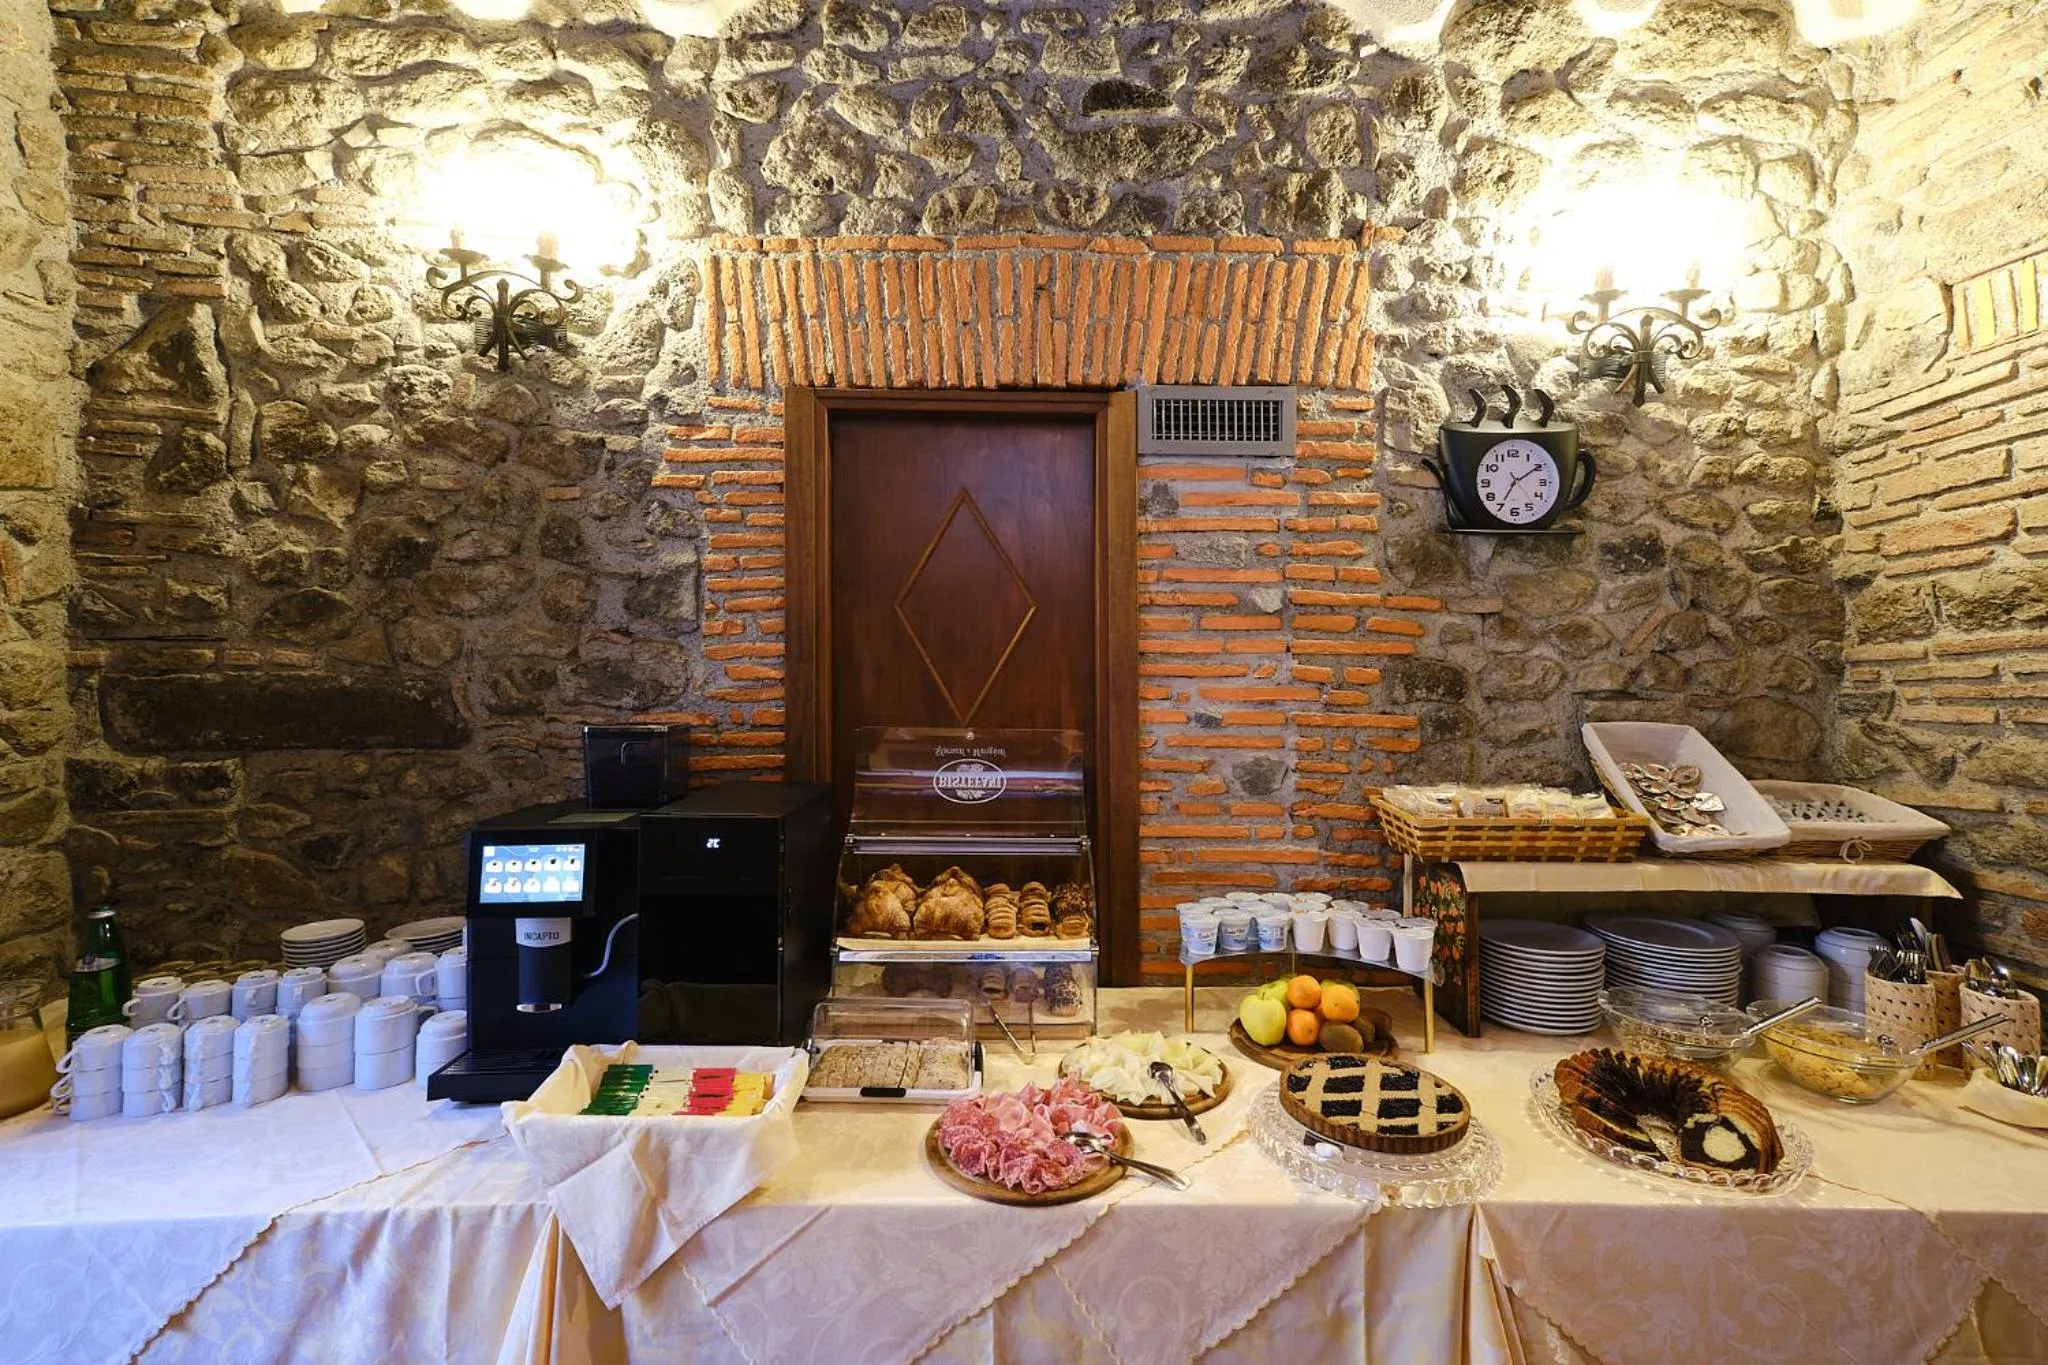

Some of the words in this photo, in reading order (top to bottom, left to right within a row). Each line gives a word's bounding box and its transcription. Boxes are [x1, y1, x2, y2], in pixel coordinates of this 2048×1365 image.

[1495, 453, 1504, 462] 11
[1507, 449, 1520, 458] 12
[1526, 453, 1530, 462] 1
[1486, 464, 1499, 473] 10
[1533, 463, 1543, 472] 2
[1480, 478, 1491, 488] 9
[1539, 478, 1547, 487] 3
[1486, 492, 1496, 502] 8
[1534, 491, 1543, 500] 4
[1496, 503, 1505, 512] 7
[1524, 502, 1534, 511] 5
[1509, 507, 1520, 517] 6
[524, 931, 560, 942] INCAPTO
